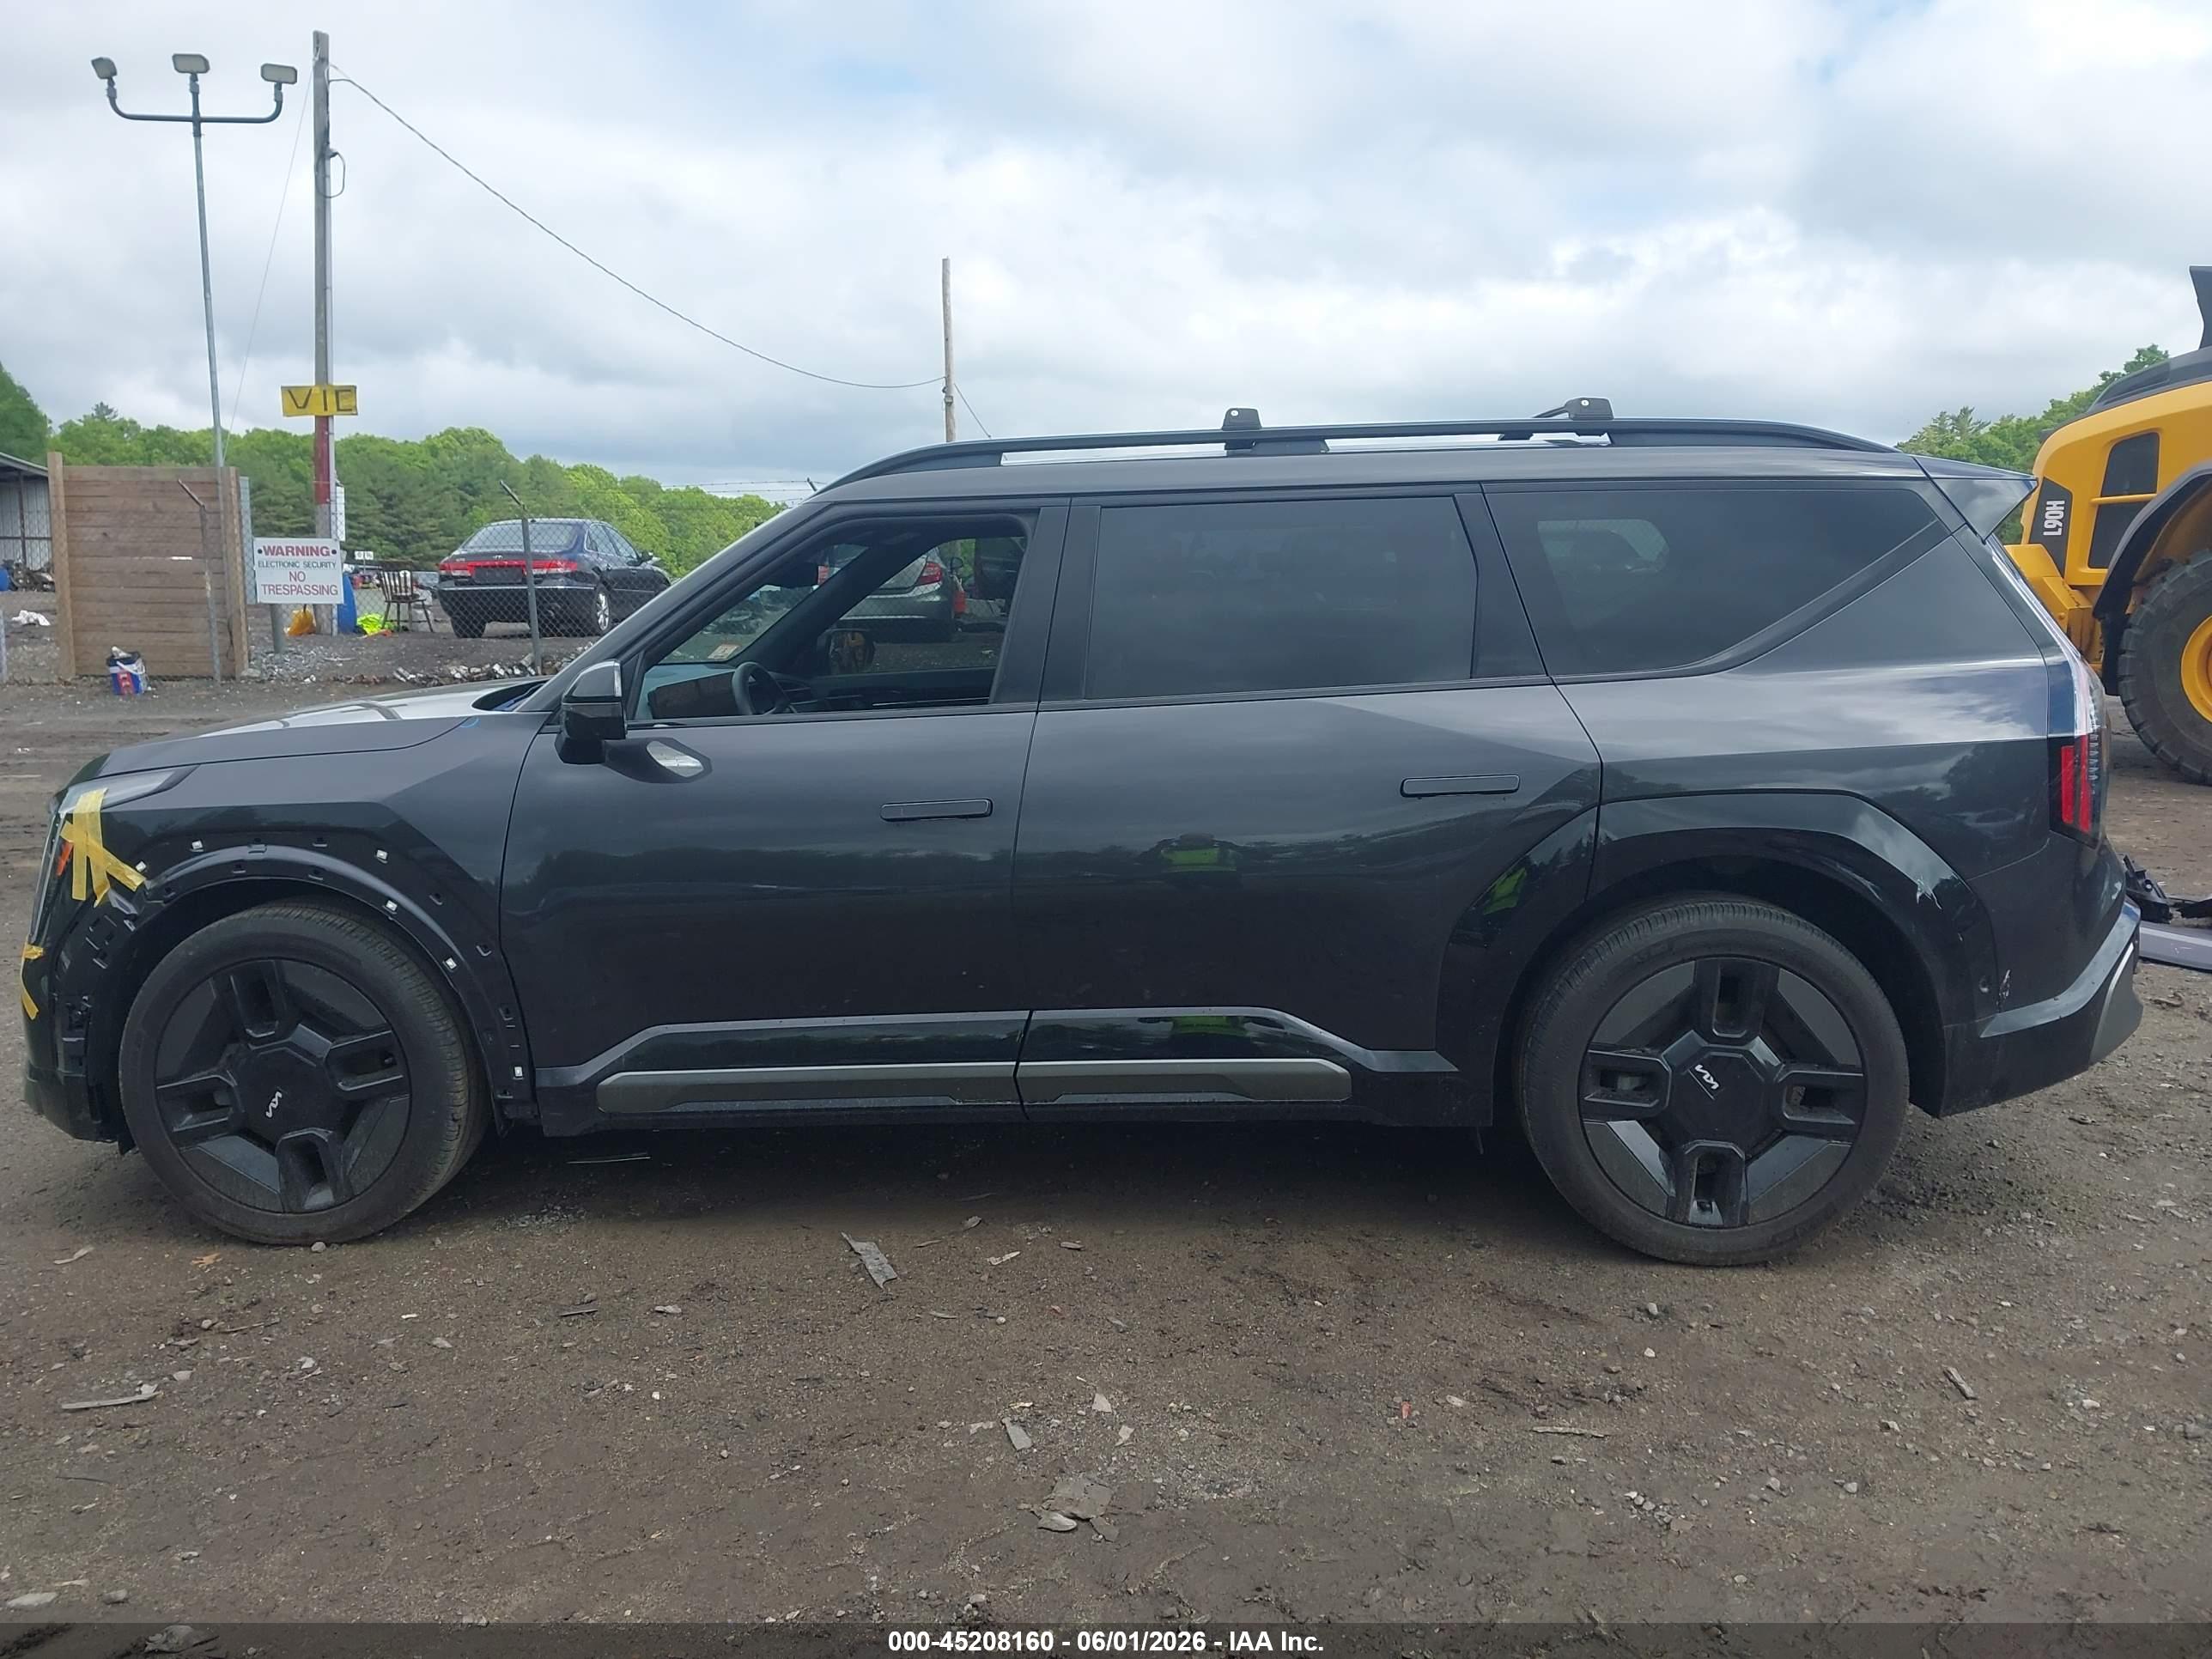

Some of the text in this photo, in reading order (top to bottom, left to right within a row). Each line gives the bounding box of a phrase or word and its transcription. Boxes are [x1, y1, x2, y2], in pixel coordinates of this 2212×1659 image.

[2043, 500, 2065, 536] L90H
[263, 545, 331, 556] WARNING
[289, 571, 307, 582] NO
[261, 584, 338, 596] TRESPASSING
